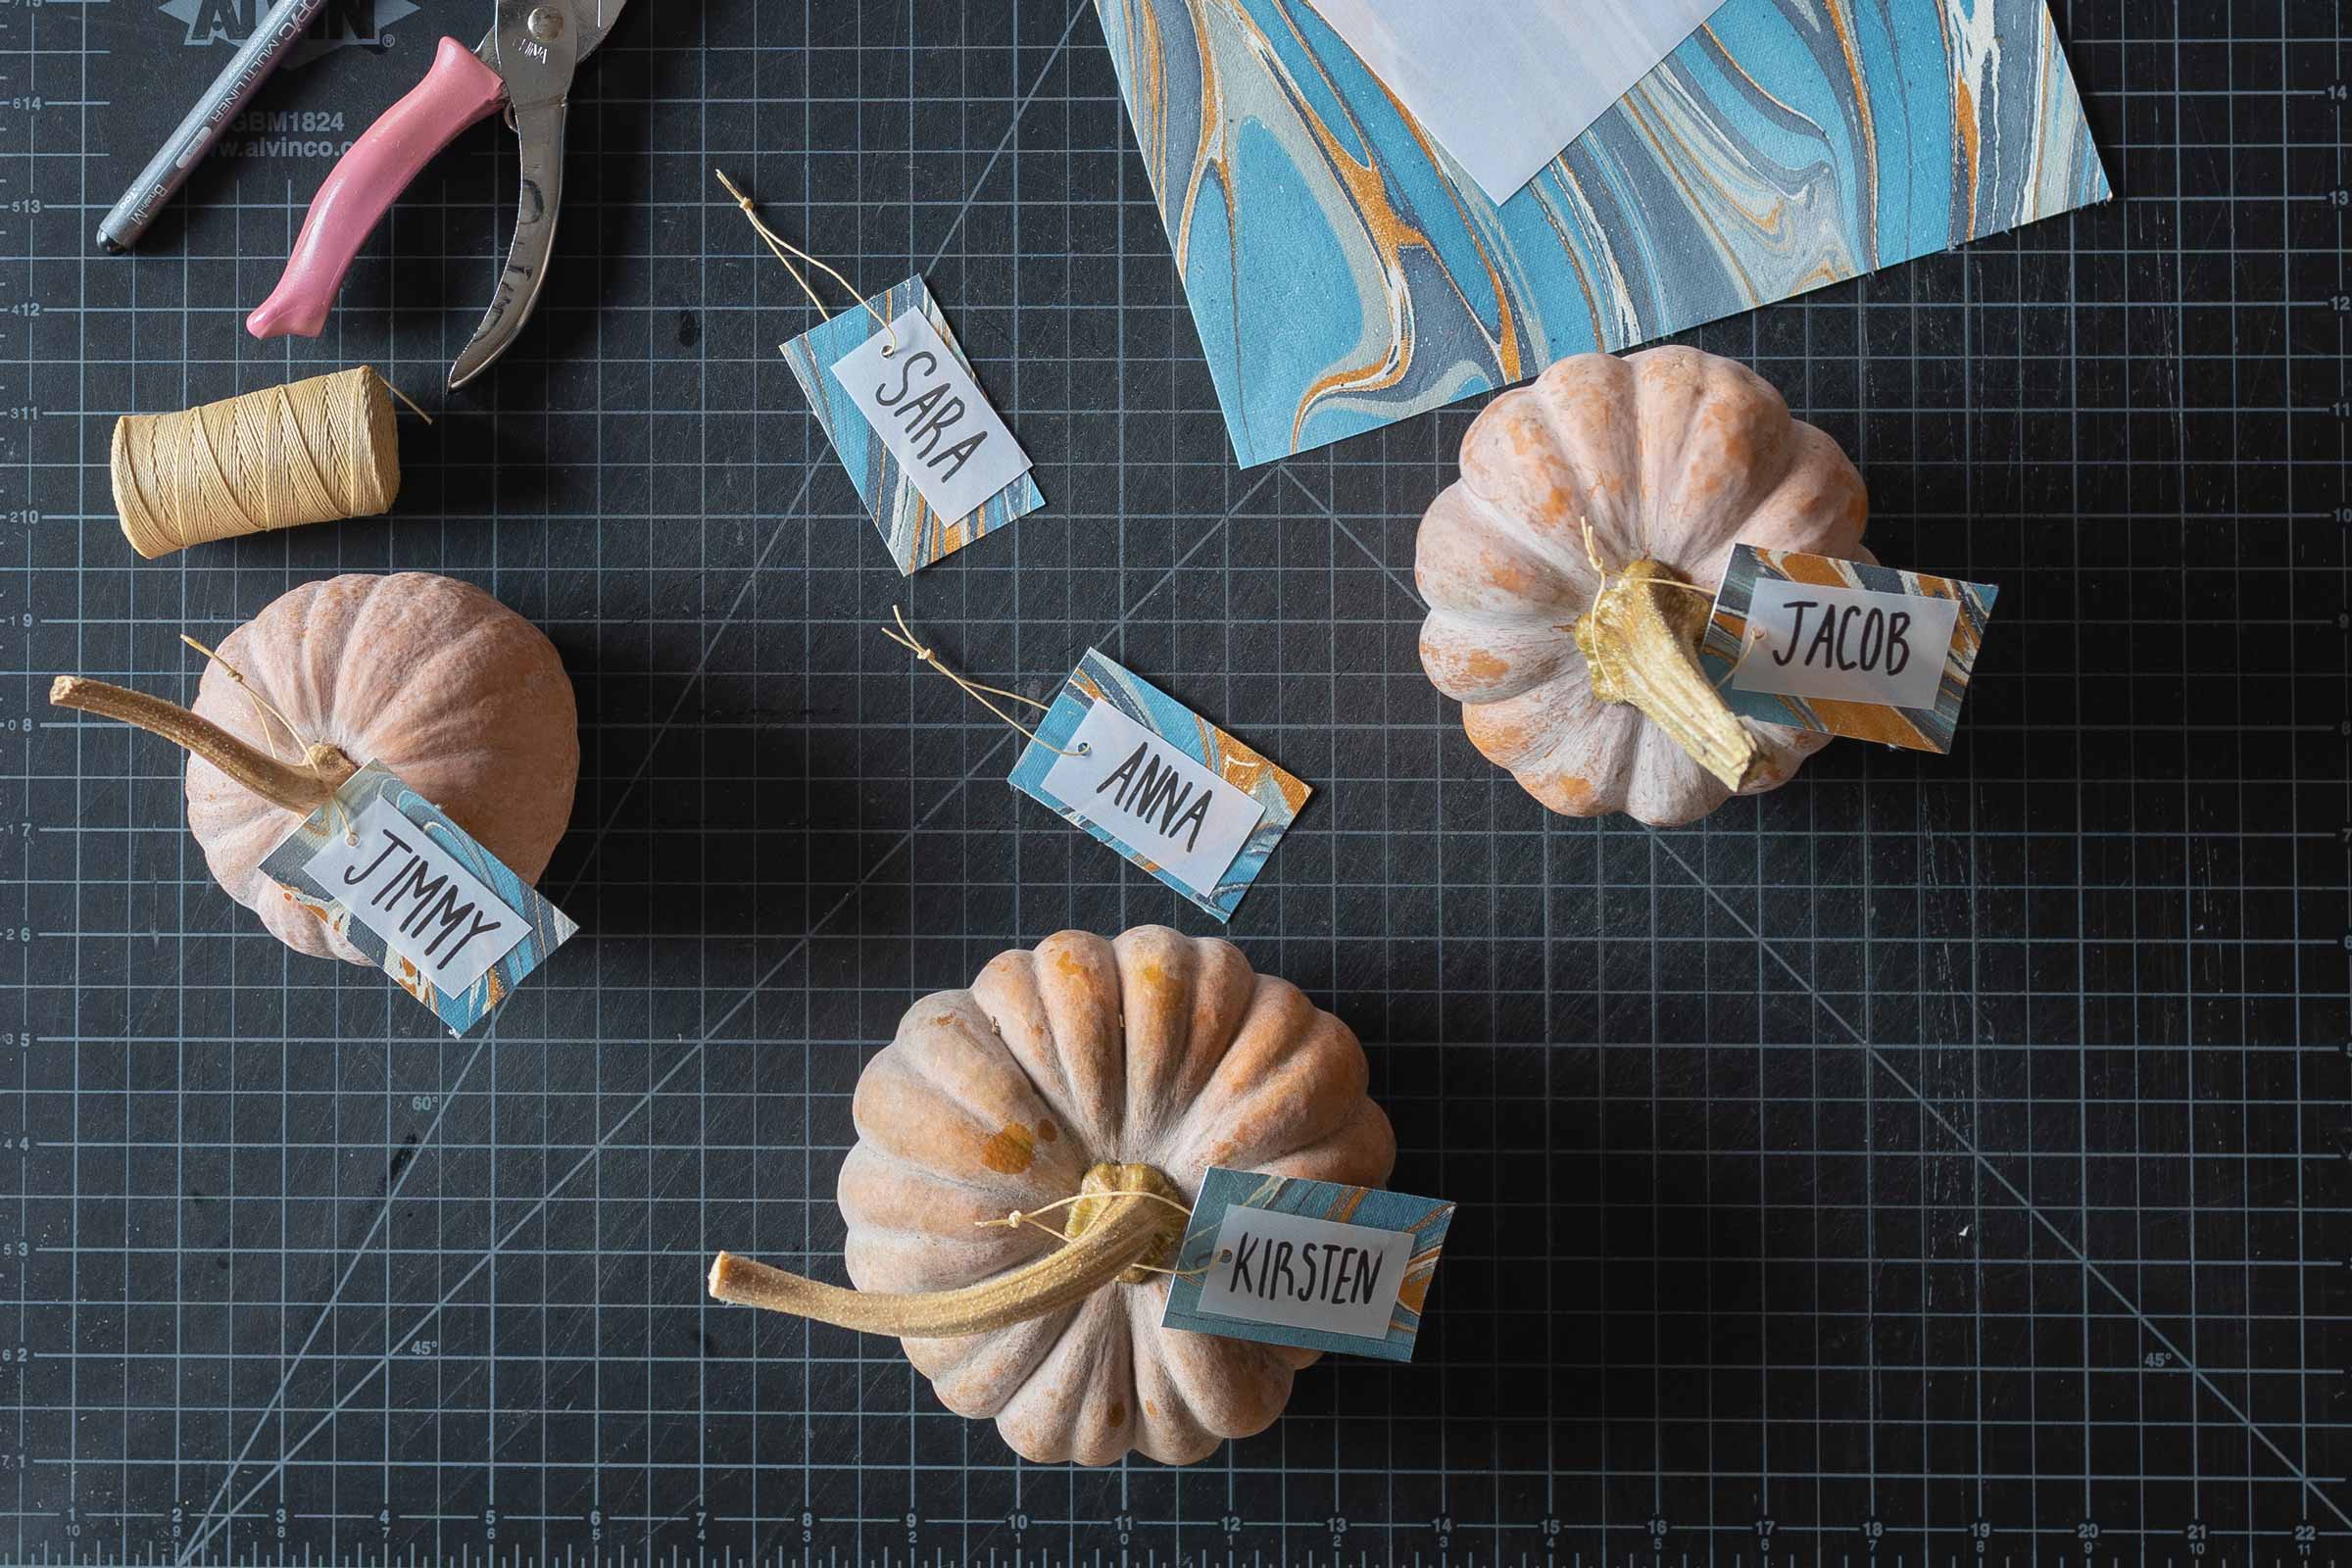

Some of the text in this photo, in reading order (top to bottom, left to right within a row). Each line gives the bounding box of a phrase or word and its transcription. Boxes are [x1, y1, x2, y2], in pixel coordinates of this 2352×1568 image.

[242, 39, 280, 82] MULTI
[210, 80, 245, 123] LINER
[2328, 84, 2348, 101] 14
[2328, 189, 2349, 206] 13
[2329, 295, 2351, 312] 12
[875, 351, 989, 484] SARA
[2331, 401, 2351, 417] 11
[2332, 507, 2352, 523] 10
[1772, 601, 1911, 676] JACOB
[1096, 741, 1213, 854] ANNA
[343, 828, 502, 971] JIMMY
[1229, 1231, 1384, 1304] KIRSTEN
[66, 1524, 2312, 1555] 10 9 8 7 6 5 4 3 2 1 0 1 2 3 4 5 6 7 8 9 10 11
[67, 1506, 2316, 1542] 1 2 3 4 5 6 7 8 9 10 11 12 13 14 15 16 17 18 19 20 21 22
